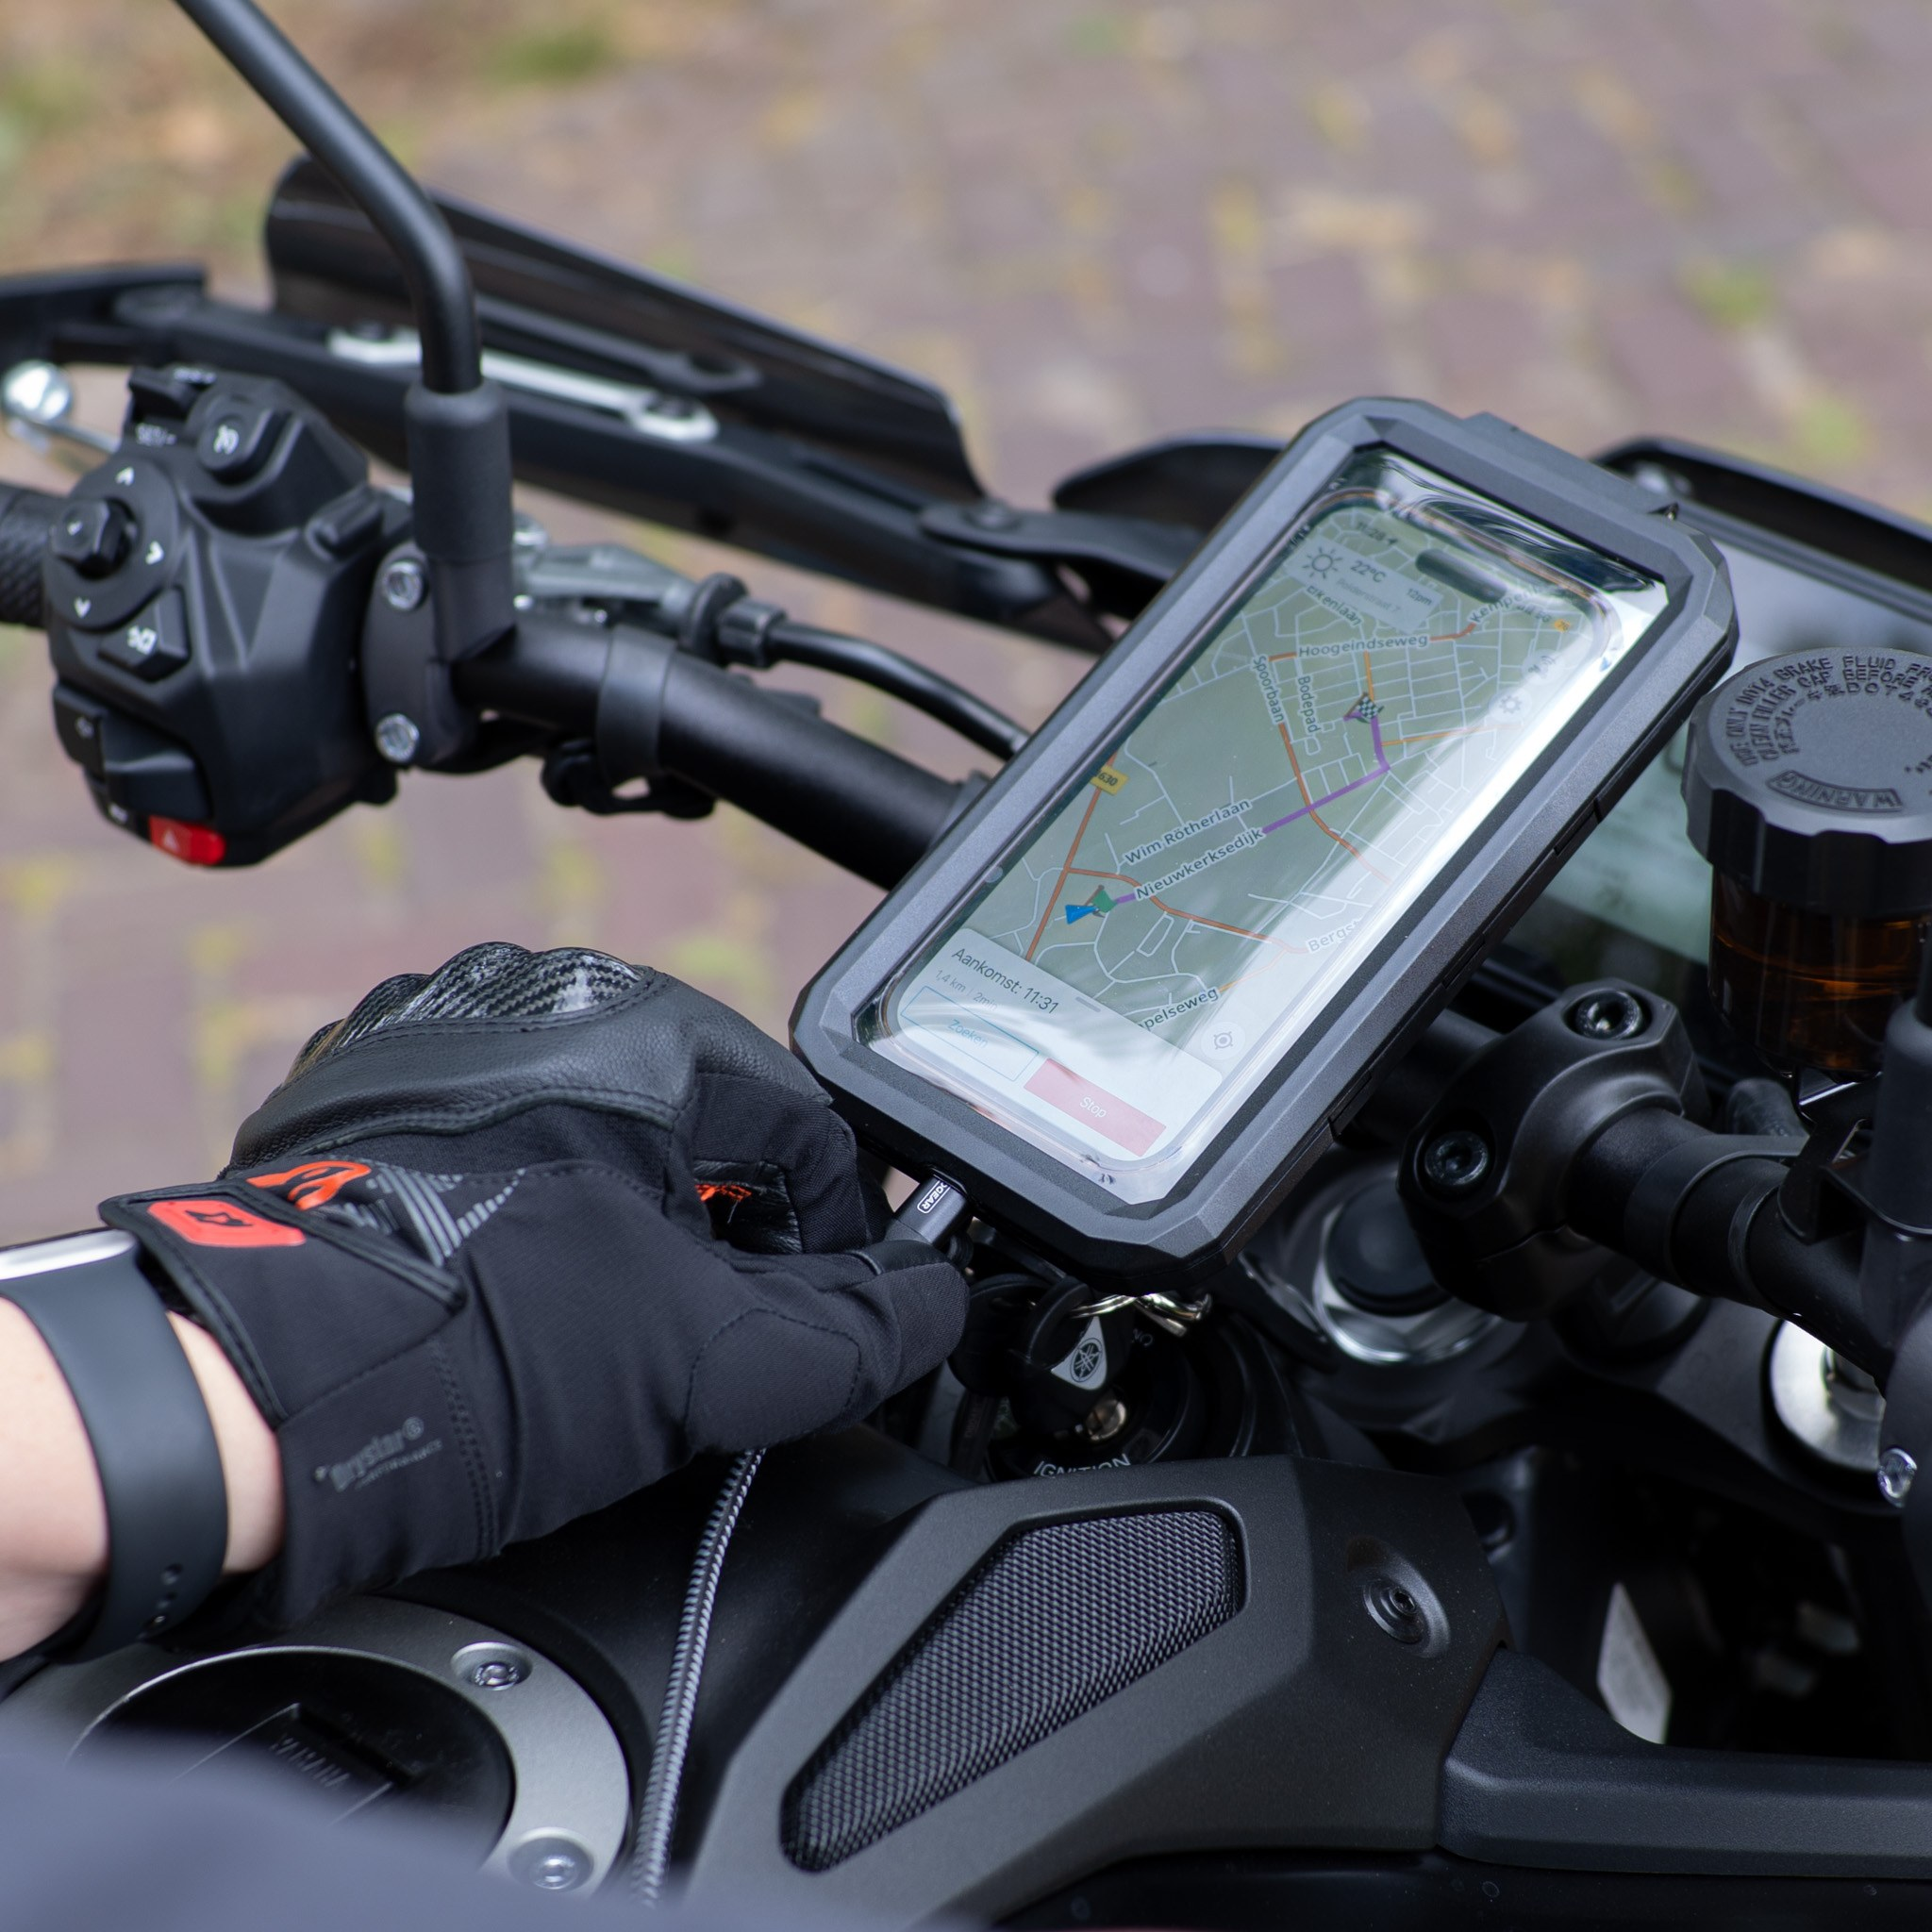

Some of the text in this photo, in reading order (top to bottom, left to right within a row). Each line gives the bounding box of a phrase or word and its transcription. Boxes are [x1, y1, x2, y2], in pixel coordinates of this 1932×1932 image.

[1407, 588, 1433, 607] 12pm
[1299, 633, 1428, 658] Hoogeindseweg
[1774, 658, 1833, 680] BRAKE
[1841, 655, 1896, 671] FLUID
[1842, 668, 1919, 689] BEFORE
[1253, 655, 1285, 724] Spoorbaan
[1297, 675, 1321, 733] Bodepad
[1779, 774, 1898, 808] WARNING
[1124, 799, 1250, 865] Wim Rötherlaan
[1136, 828, 1264, 900] Nieuwkerksedijk
[949, 977, 966, 992] km
[951, 948, 1059, 1014] Aankomst: 11:31
[1139, 988, 1219, 1031] pelseweg
[948, 1019, 989, 1048] Zoeken
[1079, 1095, 1108, 1119] Stop
[1034, 1452, 1132, 1479] IGNON
